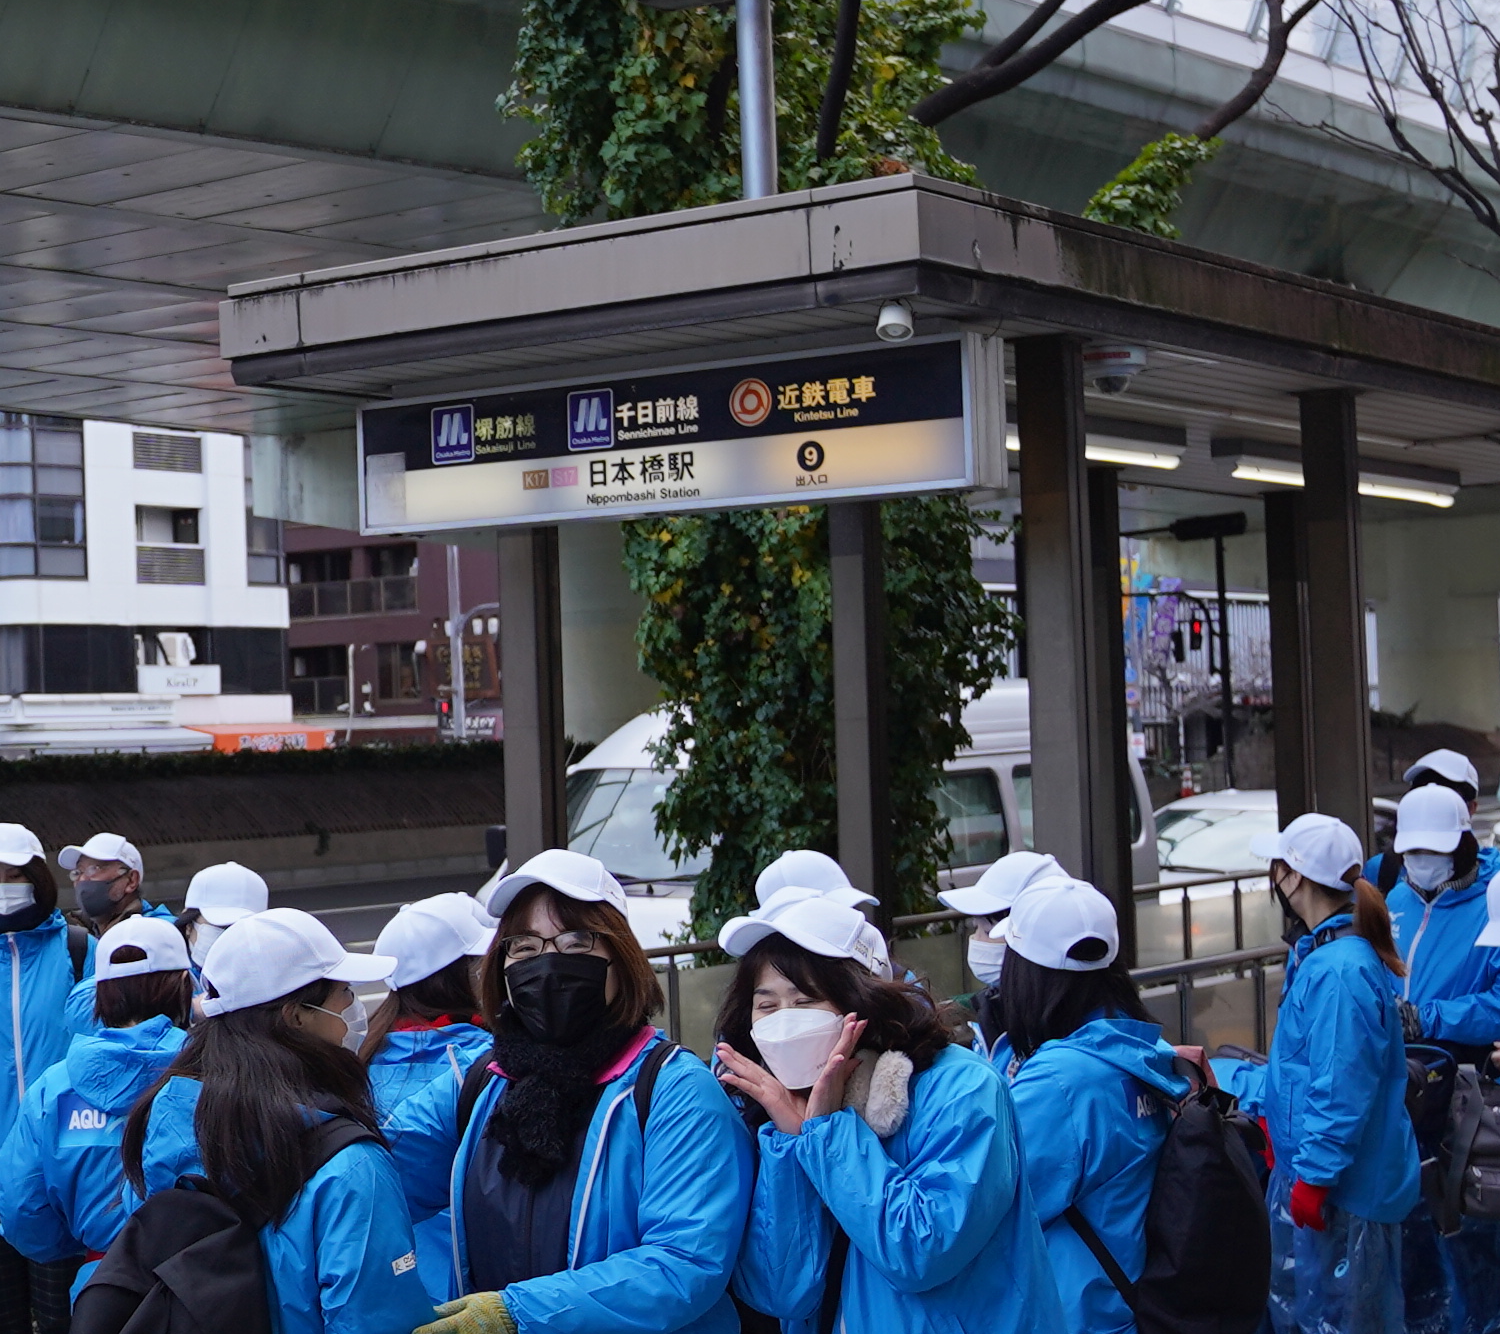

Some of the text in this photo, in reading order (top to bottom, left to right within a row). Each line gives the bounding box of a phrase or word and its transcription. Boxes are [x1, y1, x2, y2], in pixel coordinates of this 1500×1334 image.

[777, 375, 876, 410] 近鉄電車
[615, 395, 700, 427] 千日前線
[793, 406, 859, 424] Kintetsu Line
[475, 413, 536, 440] 堺筋線
[617, 422, 699, 442] Sennichimae Line
[804, 446, 818, 467] 9
[524, 471, 546, 488] K17
[554, 469, 576, 485] S17
[589, 451, 695, 488] 日本橋駅
[795, 474, 828, 487] 出入口
[586, 486, 700, 506] Nippombashi Station
